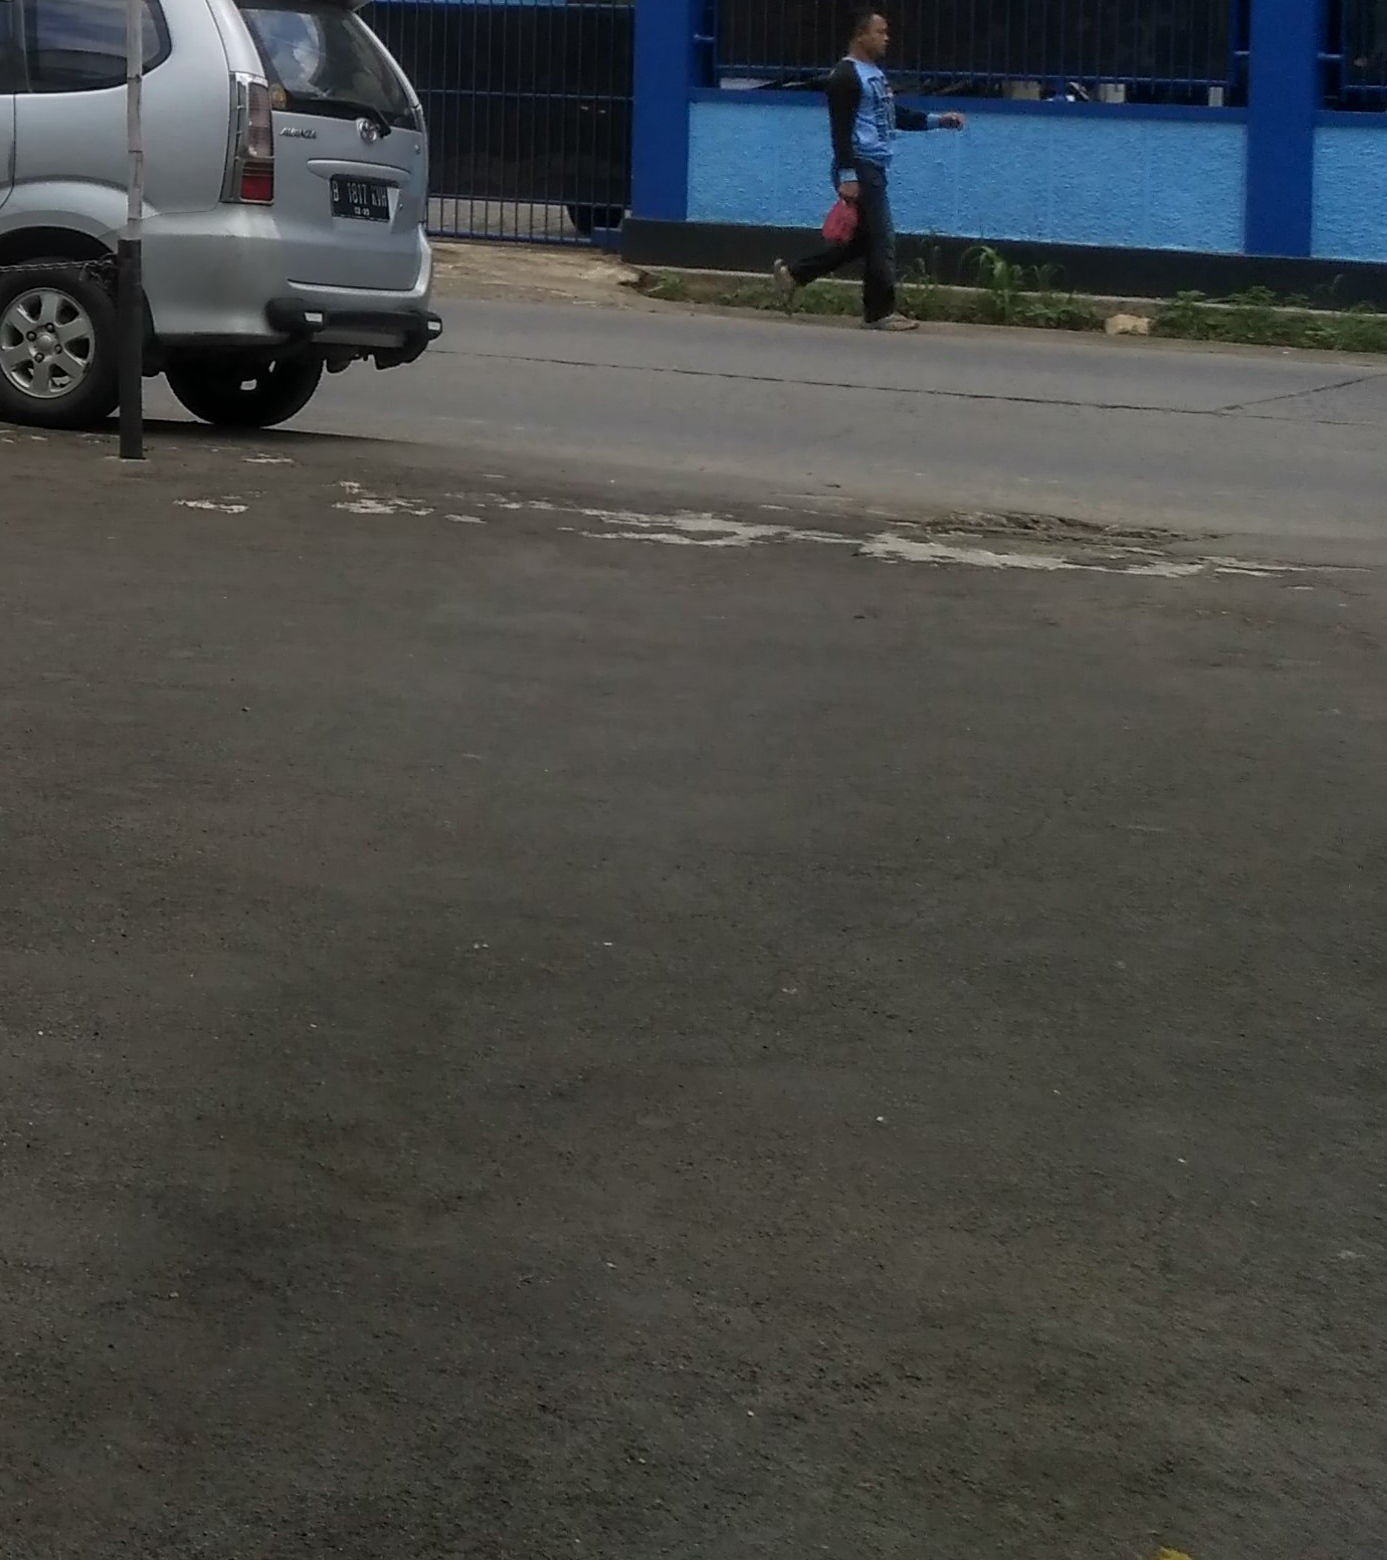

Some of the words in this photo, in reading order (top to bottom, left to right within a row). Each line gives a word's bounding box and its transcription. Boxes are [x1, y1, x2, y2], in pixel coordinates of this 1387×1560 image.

[279, 127, 317, 139] AVANZA
[331, 180, 339, 202] B
[346, 182, 367, 205] 1817
